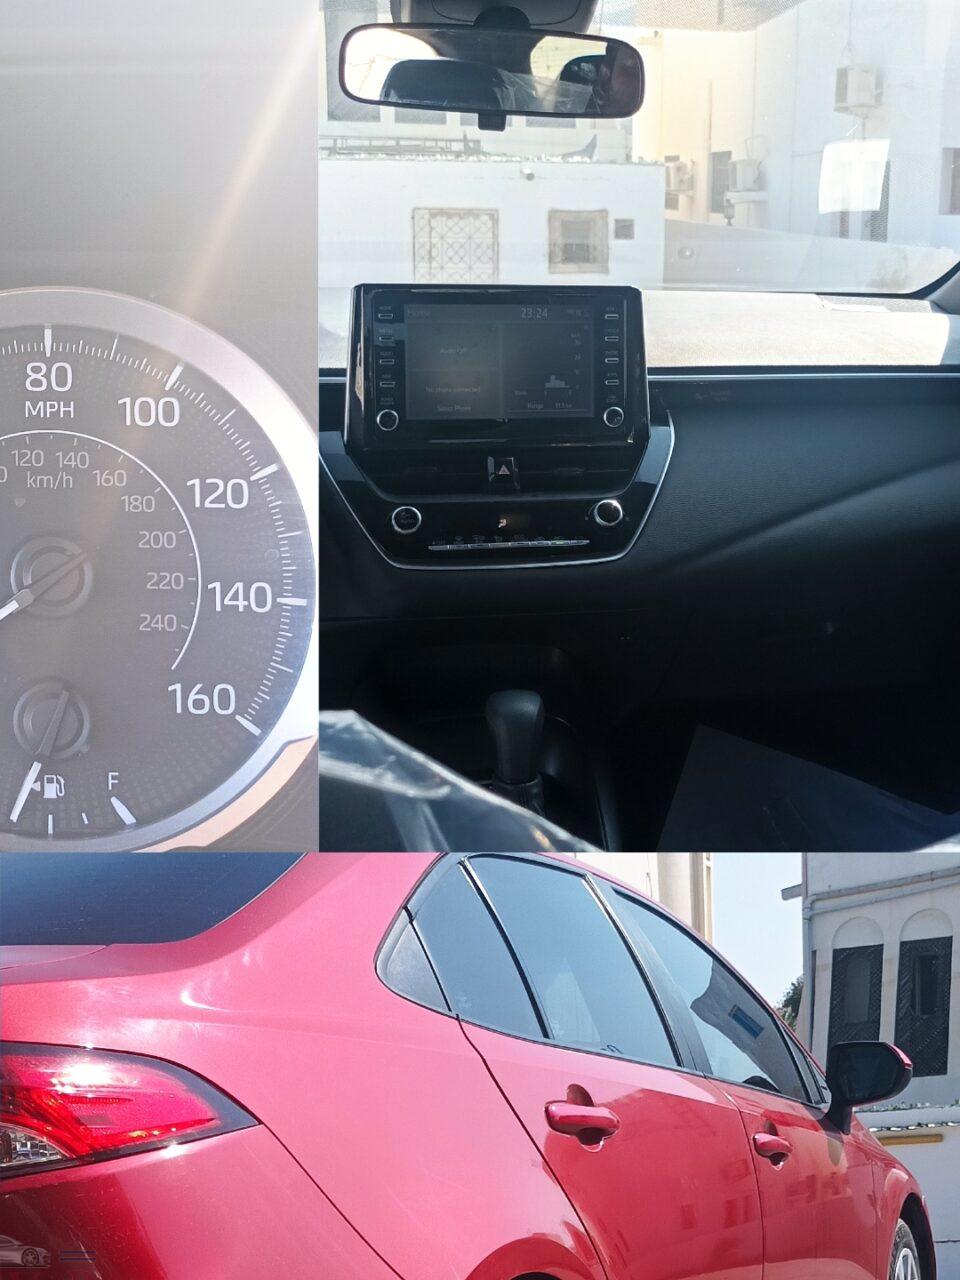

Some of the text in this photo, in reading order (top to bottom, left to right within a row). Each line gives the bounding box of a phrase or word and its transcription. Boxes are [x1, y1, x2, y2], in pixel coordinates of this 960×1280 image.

[521, 307, 549, 319] 23:24
[25, 362, 73, 392] 80
[25, 401, 74, 418] MPH
[117, 396, 180, 427] 100
[11, 449, 45, 467] 120
[55, 451, 90, 469] 140
[27, 470, 73, 489] km/h
[92, 469, 127, 487] 160
[187, 479, 249, 509] 120
[120, 495, 156, 513] 180
[138, 531, 176, 549] 200
[146, 572, 184, 590] 220
[207, 581, 273, 613] 140
[139, 613, 177, 632] 240
[167, 683, 237, 714] 160
[108, 771, 119, 790] F
